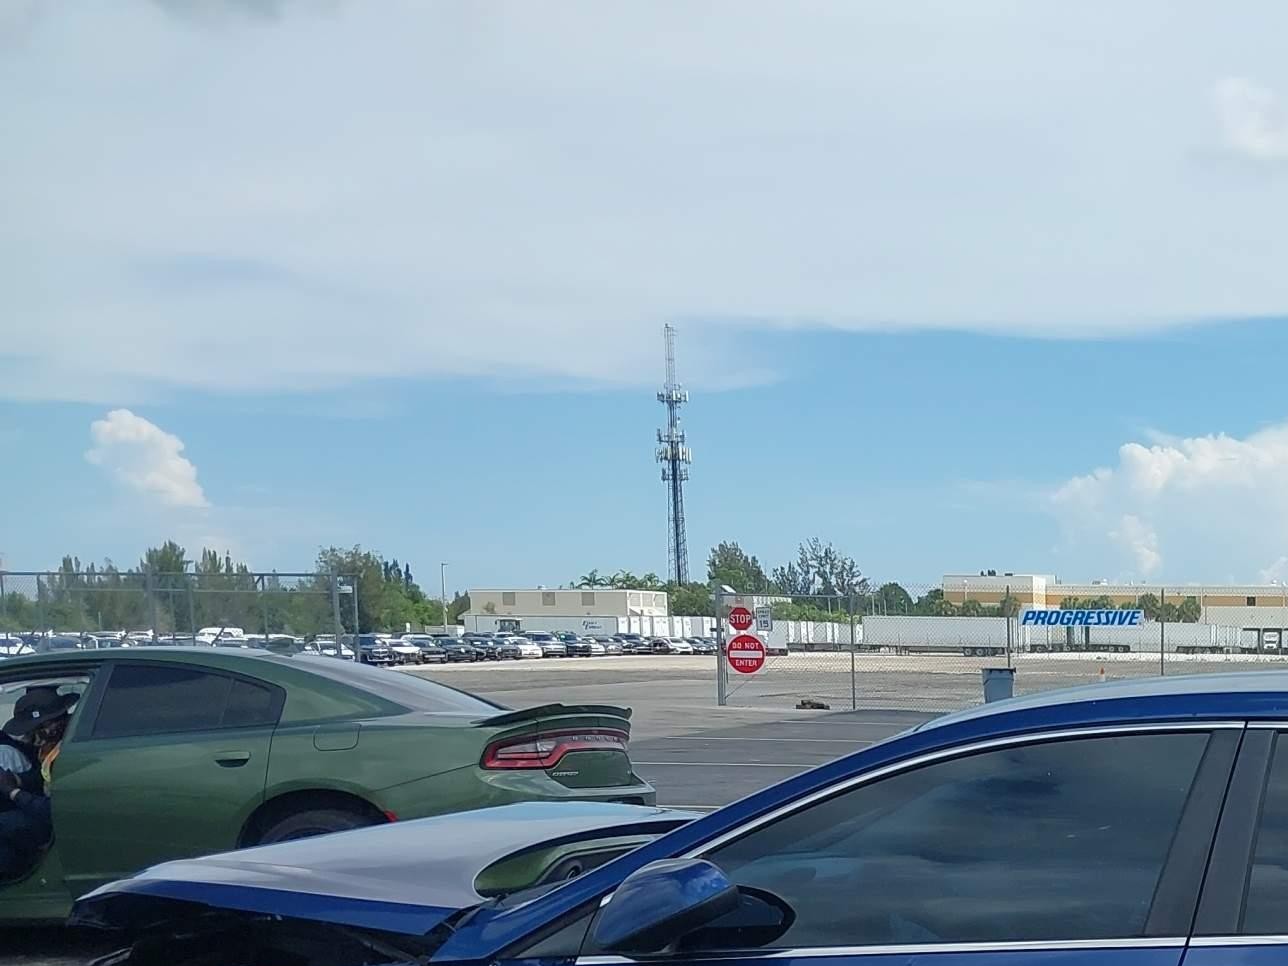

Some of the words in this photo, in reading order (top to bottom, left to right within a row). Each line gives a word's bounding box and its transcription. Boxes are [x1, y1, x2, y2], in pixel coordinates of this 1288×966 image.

[730, 614, 751, 624] STOP
[1022, 610, 1141, 626] PROGRESSIVE
[760, 620, 769, 628] 15
